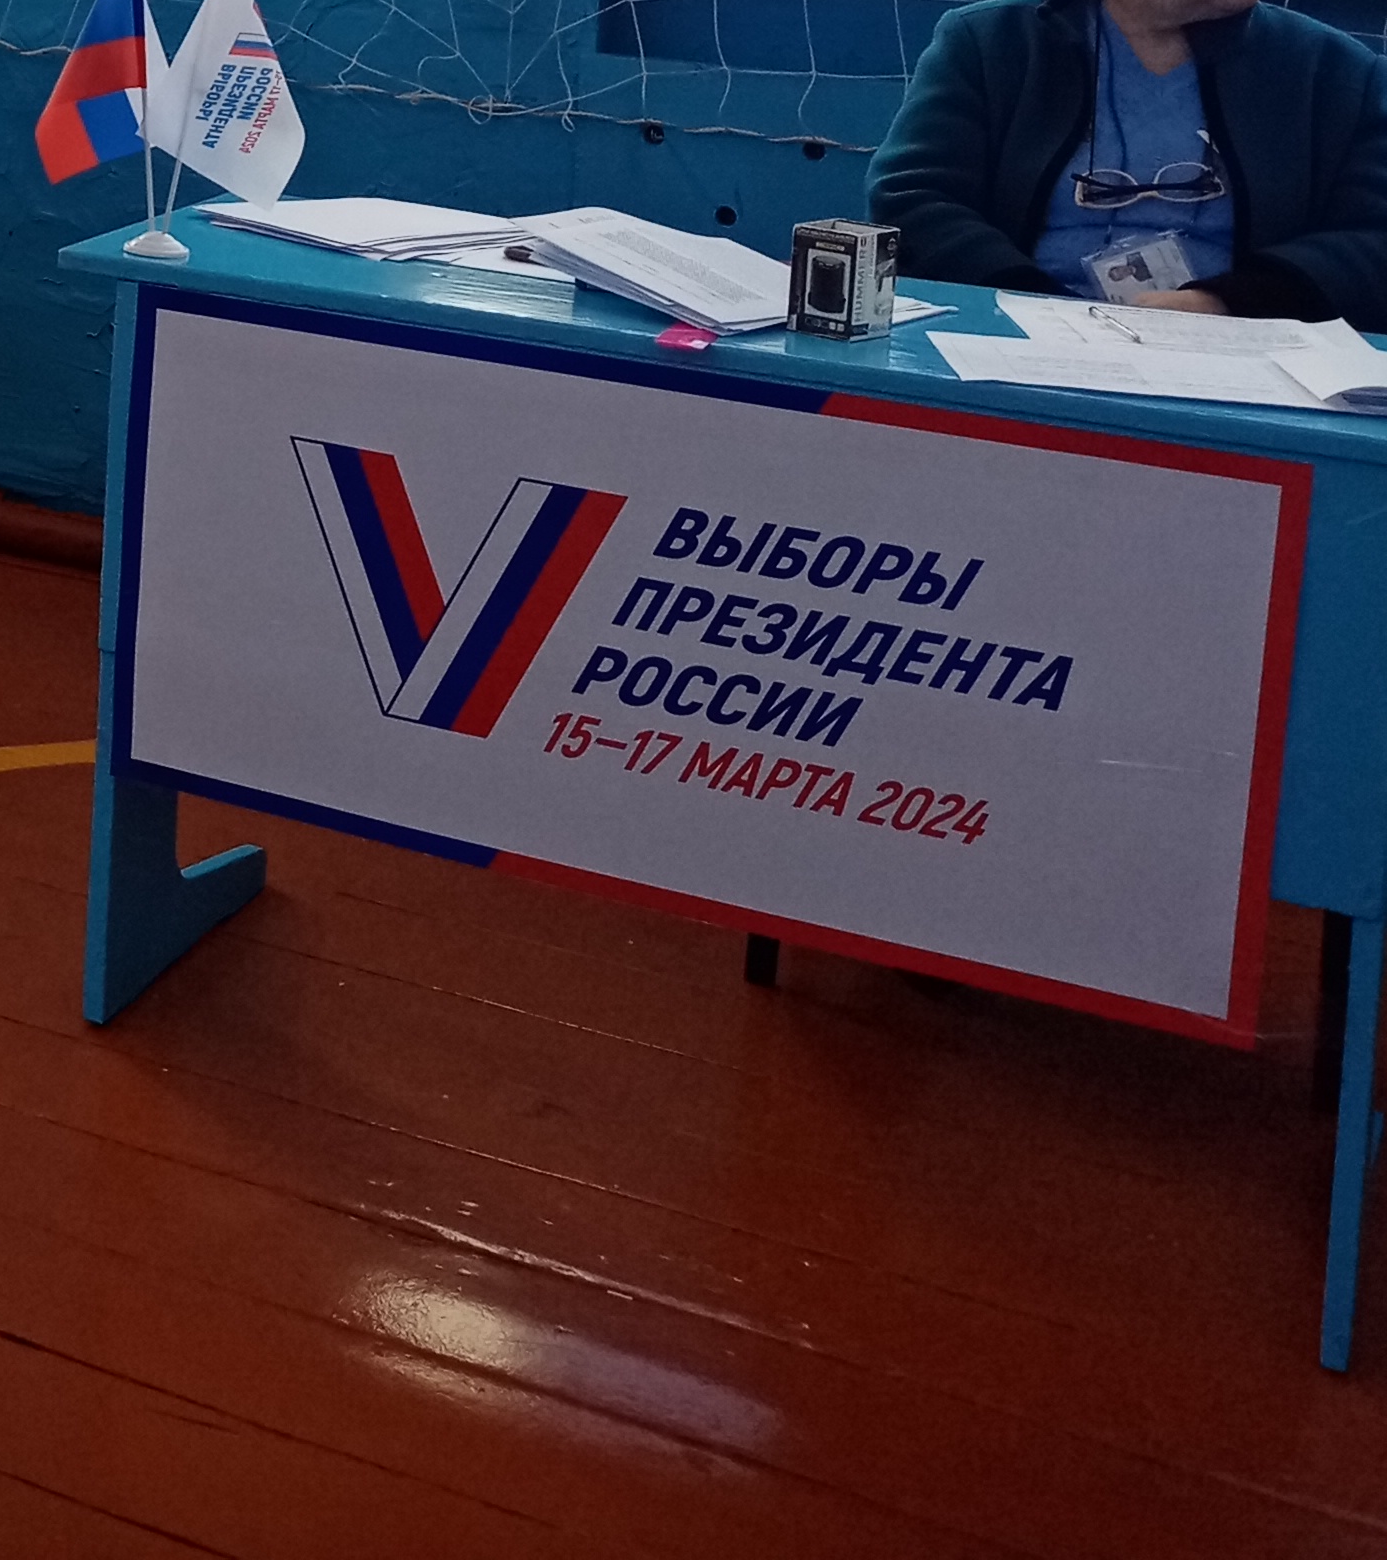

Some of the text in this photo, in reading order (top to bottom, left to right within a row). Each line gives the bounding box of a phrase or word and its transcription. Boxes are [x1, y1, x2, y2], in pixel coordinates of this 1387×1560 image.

[652, 507, 985, 611] ВЫБОРЫ
[571, 645, 865, 747] РОССИИ
[612, 576, 1075, 712] ПРЕЗИДЕНТА
[543, 712, 990, 846] 15–17 МАРТА 2024
